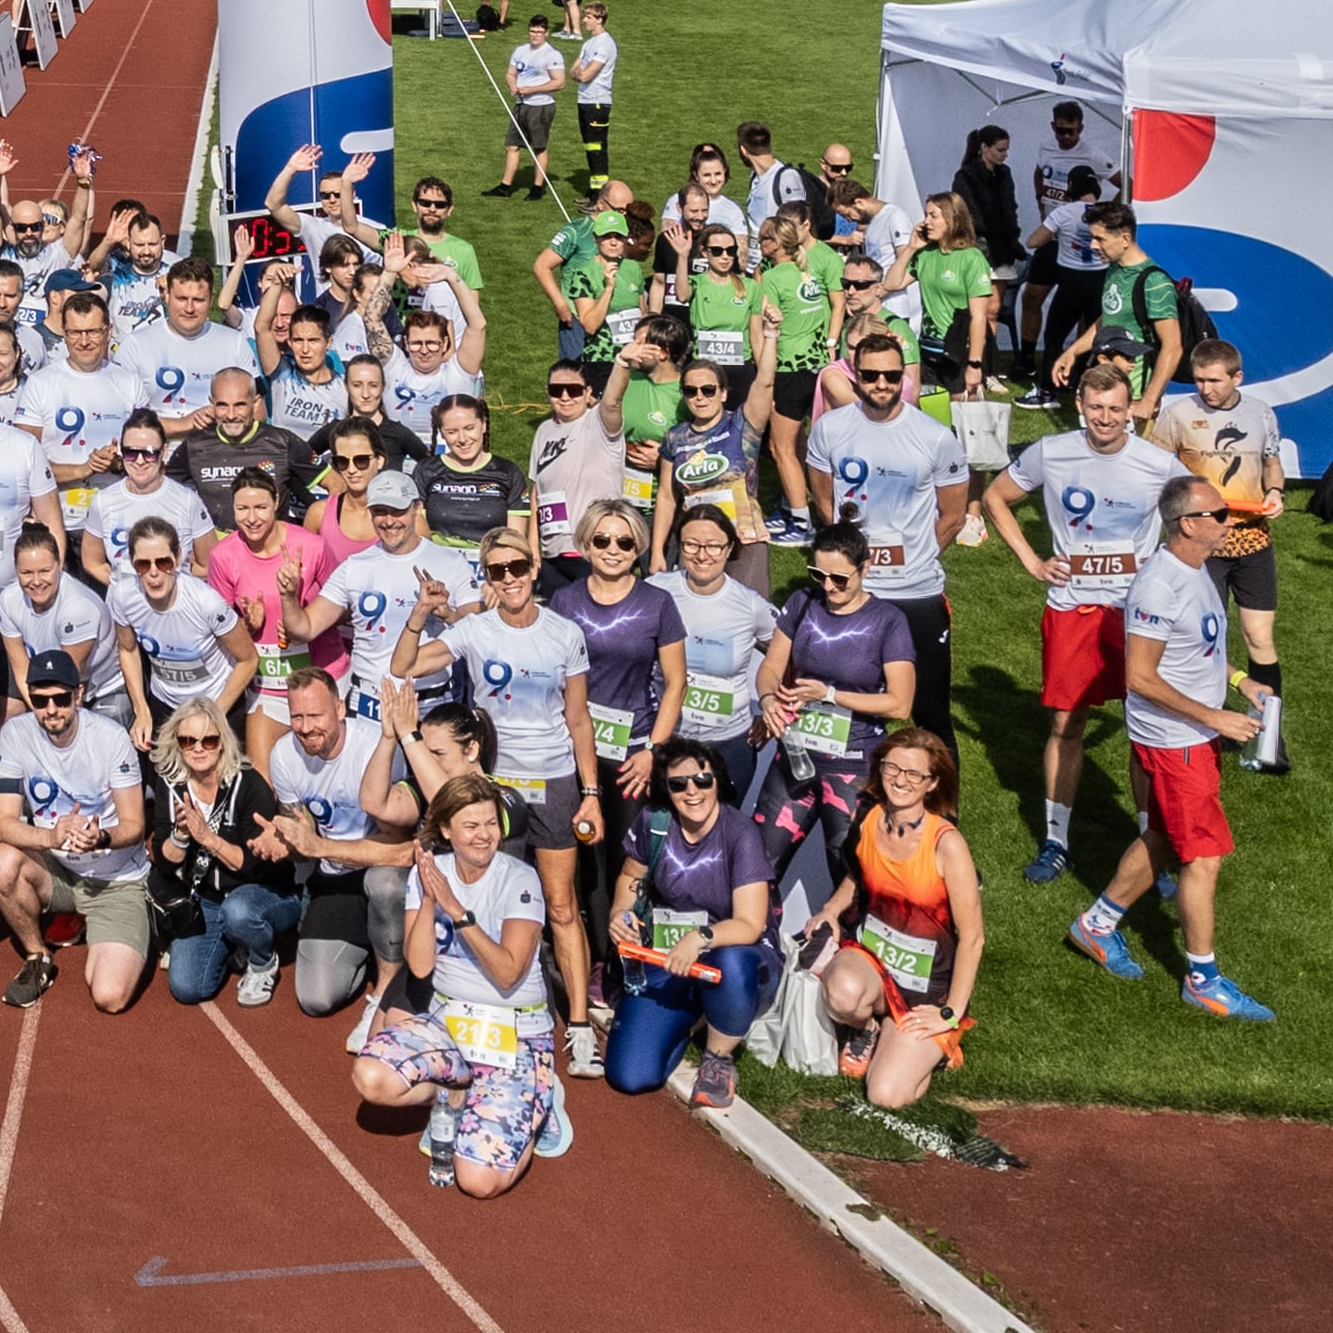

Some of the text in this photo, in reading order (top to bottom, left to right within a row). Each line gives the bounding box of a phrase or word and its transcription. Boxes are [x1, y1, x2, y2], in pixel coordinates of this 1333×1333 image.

[707, 343, 735, 355] 43/4
[290, 396, 323, 412] IRON
[284, 406, 320, 427] TEAM
[683, 460, 718, 479] Arla
[1081, 557, 1123, 574] 47/5
[162, 668, 196, 682] 57/5
[265, 658, 291, 676] 6/1
[689, 690, 720, 712] 3/5
[797, 718, 833, 737] 13/3
[876, 941, 917, 972] 13/2
[456, 1021, 502, 1048] 213
